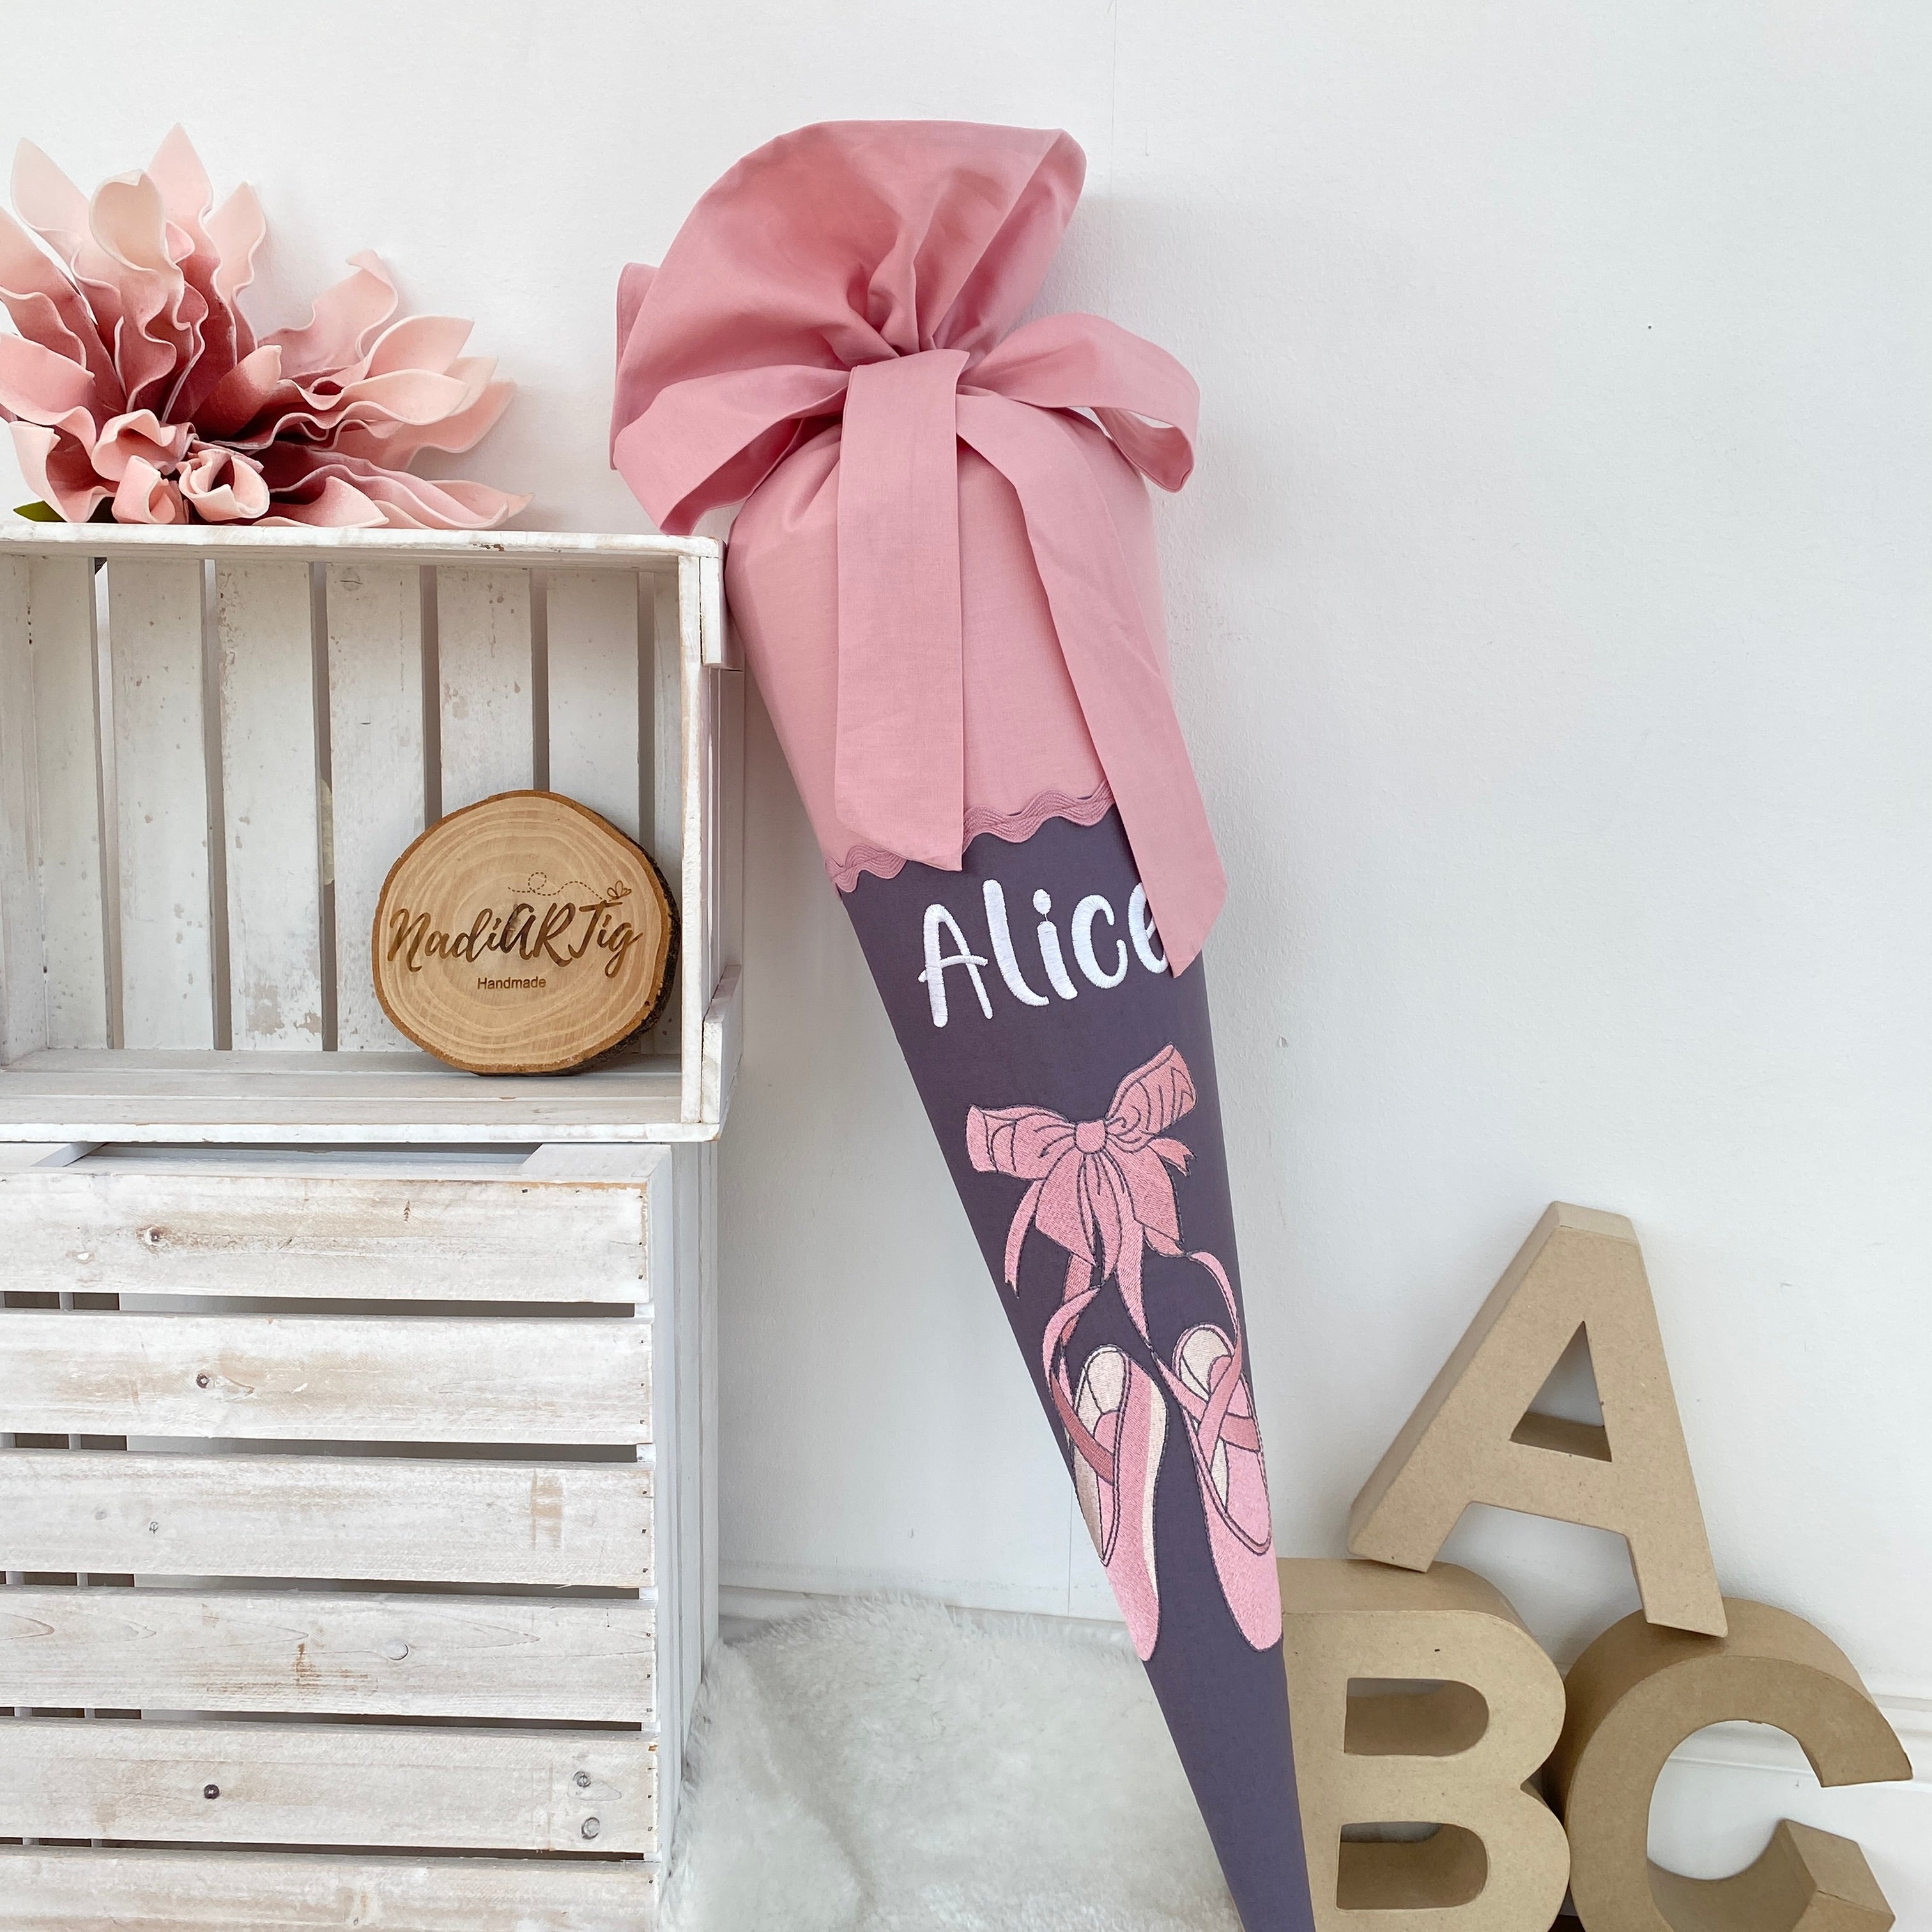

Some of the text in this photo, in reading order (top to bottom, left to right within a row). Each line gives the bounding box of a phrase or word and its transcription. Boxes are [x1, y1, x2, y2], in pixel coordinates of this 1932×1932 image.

[387, 900, 643, 978] NadiARTig
[477, 976, 546, 990] Handmade
[1347, 1201, 1728, 1637] A
[1276, 1558, 1913, 1932] B C
